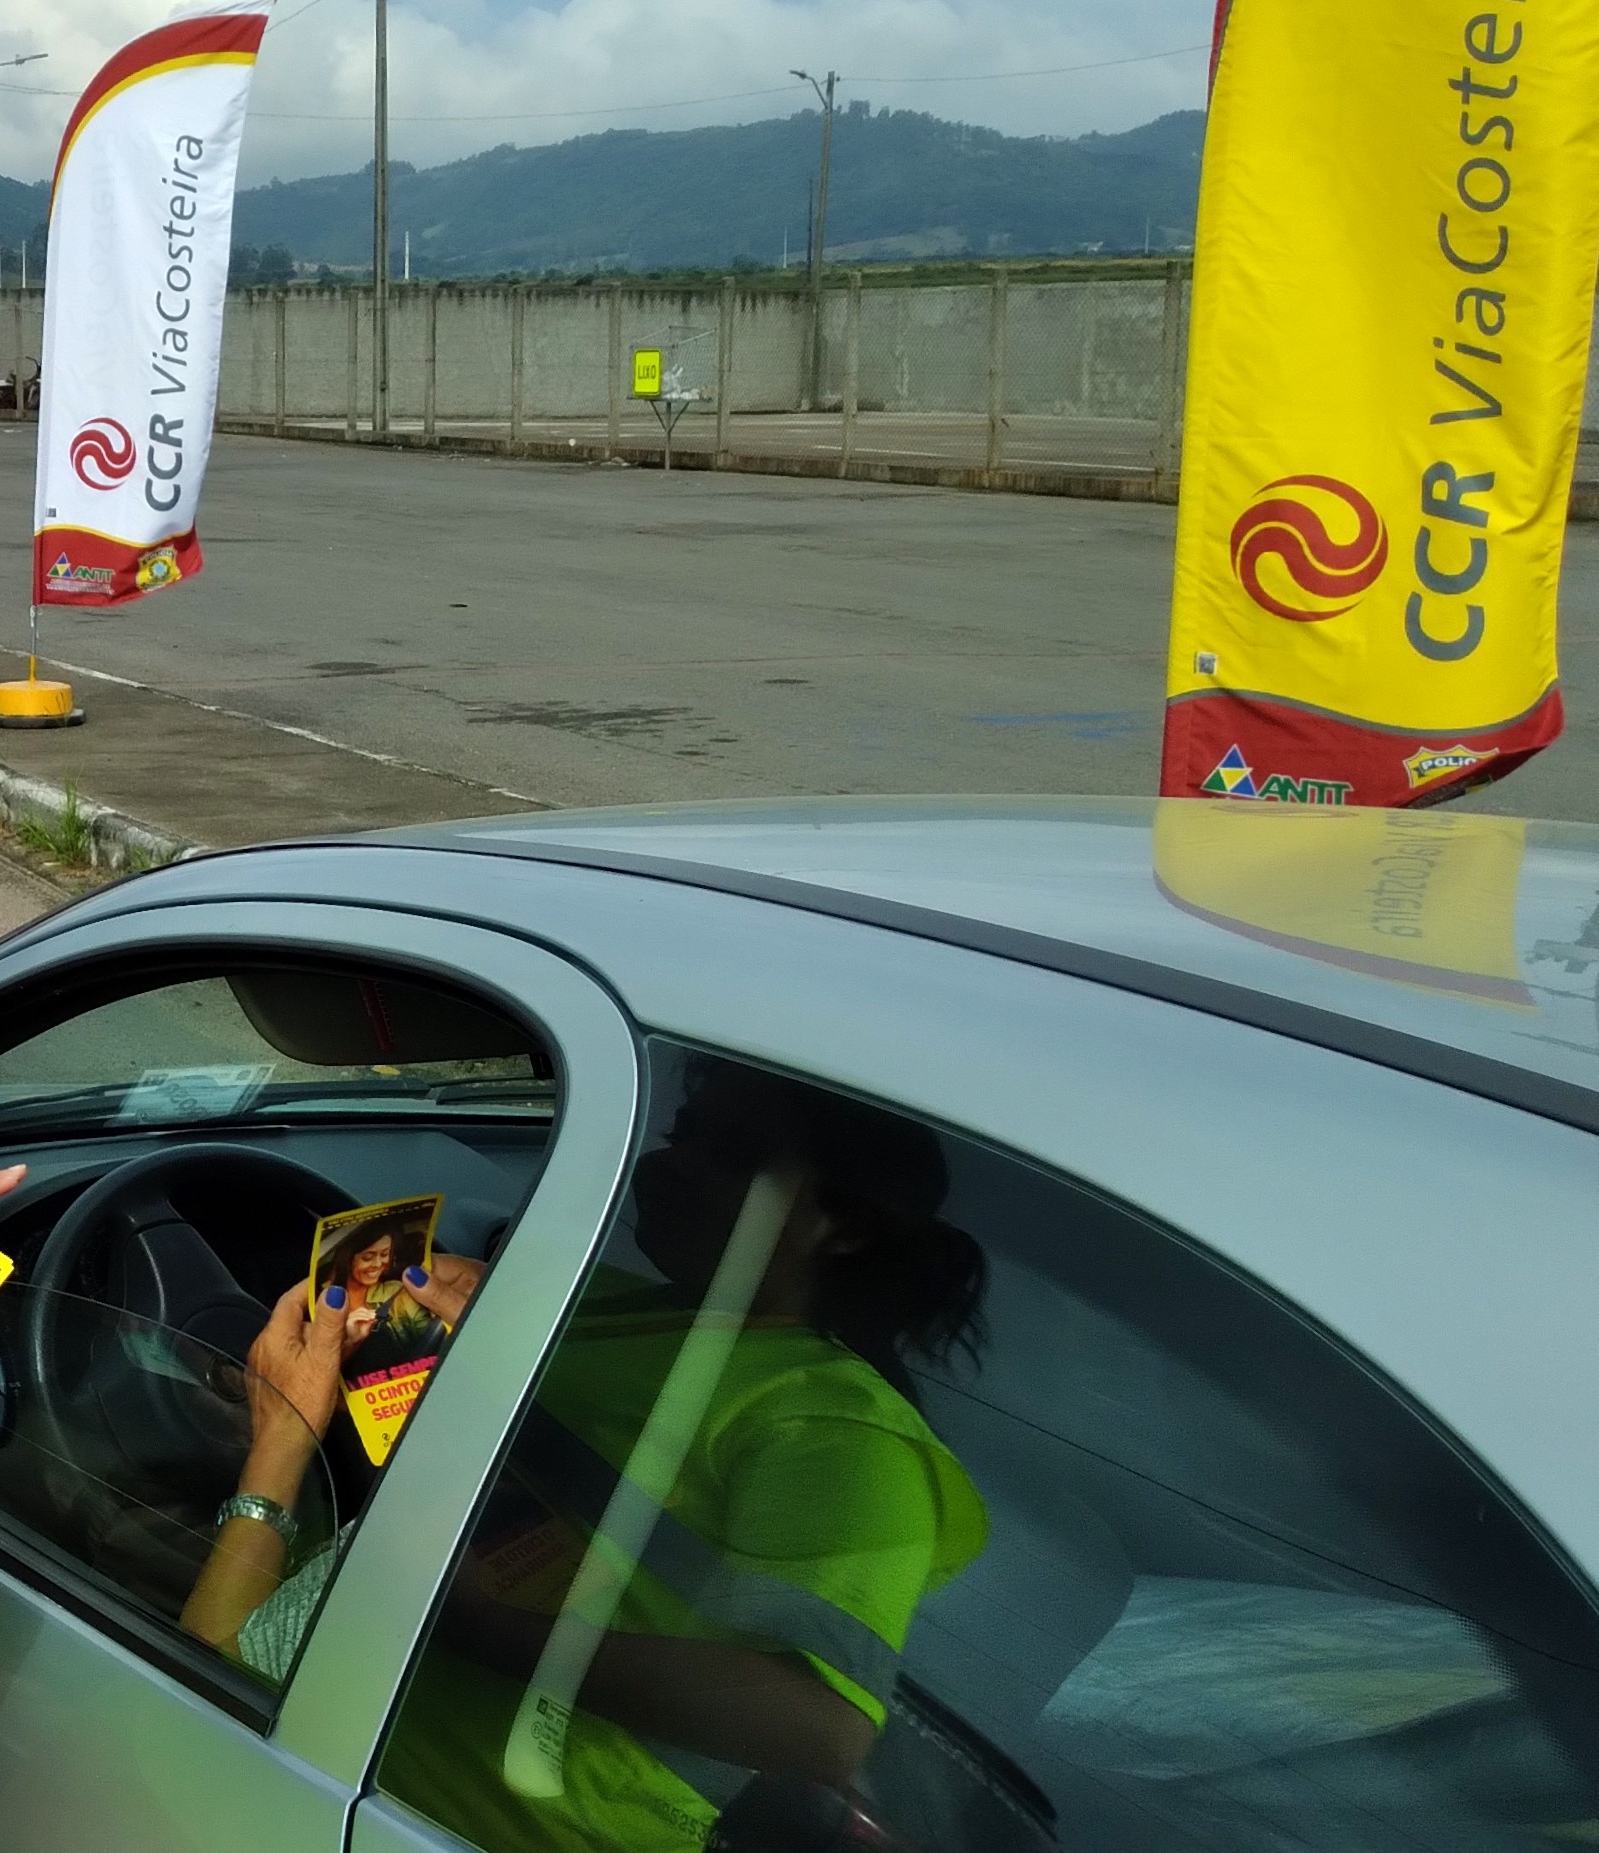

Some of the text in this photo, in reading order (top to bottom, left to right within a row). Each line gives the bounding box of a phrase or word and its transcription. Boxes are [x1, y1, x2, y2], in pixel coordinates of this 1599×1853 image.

[151, 134, 204, 395] ViaCosteira
[1405, 0, 1525, 662] CCR ViaCoste
[638, 364, 657, 379] LIXO
[144, 413, 185, 512] CCR
[72, 565, 116, 583] ANTT
[1258, 773, 1353, 806] ANTT
[357, 1369, 389, 1388] USE
[364, 1379, 422, 1405] O CINTO
